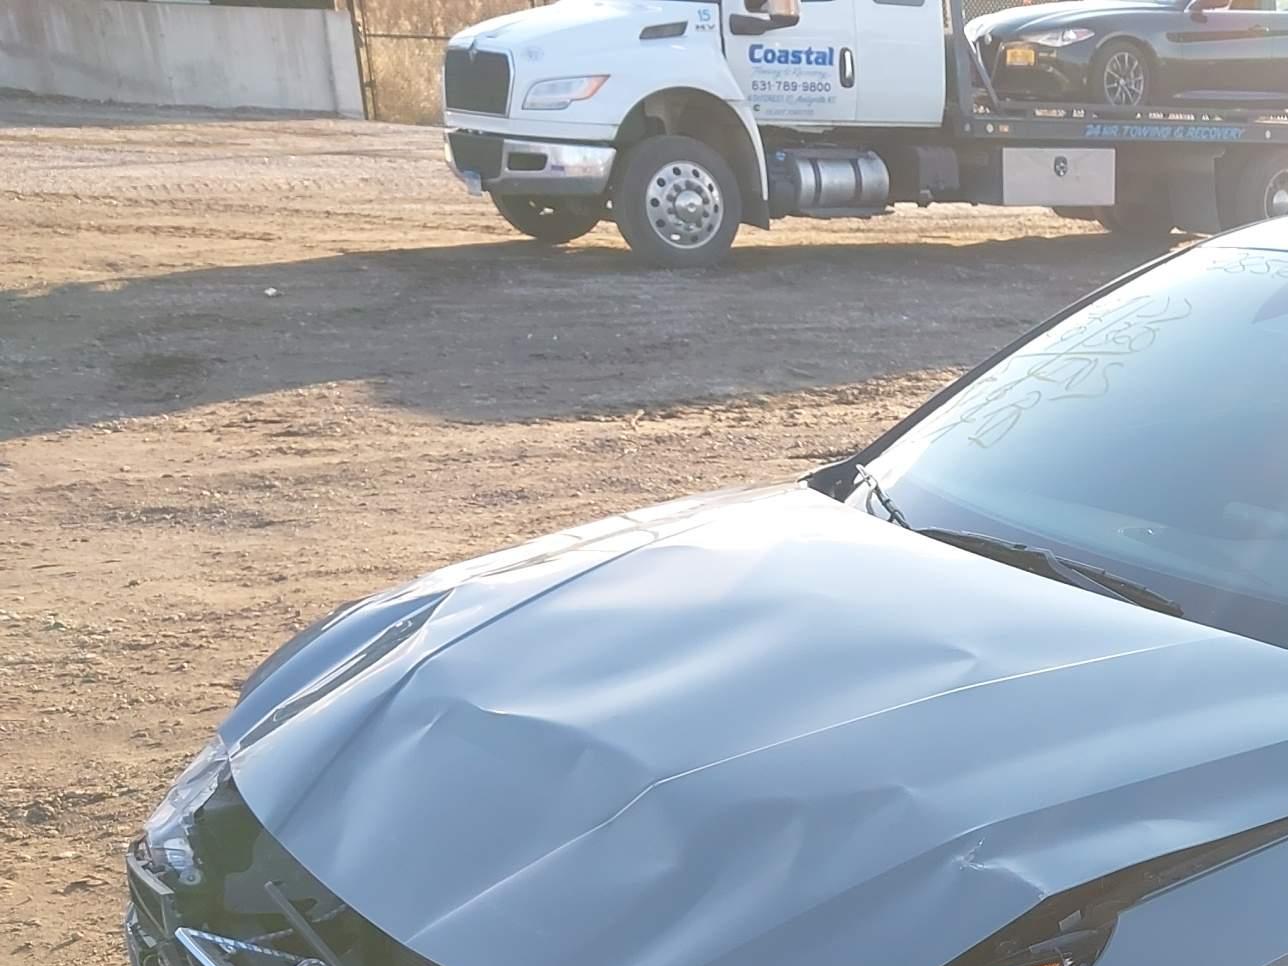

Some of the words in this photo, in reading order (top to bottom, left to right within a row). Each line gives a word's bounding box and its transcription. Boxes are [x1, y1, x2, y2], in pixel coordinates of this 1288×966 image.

[749, 44, 834, 66] Coastal
[1086, 124, 1101, 136] 24
[1122, 126, 1172, 138] TOWING
[1186, 127, 1246, 140] RECOVERY
